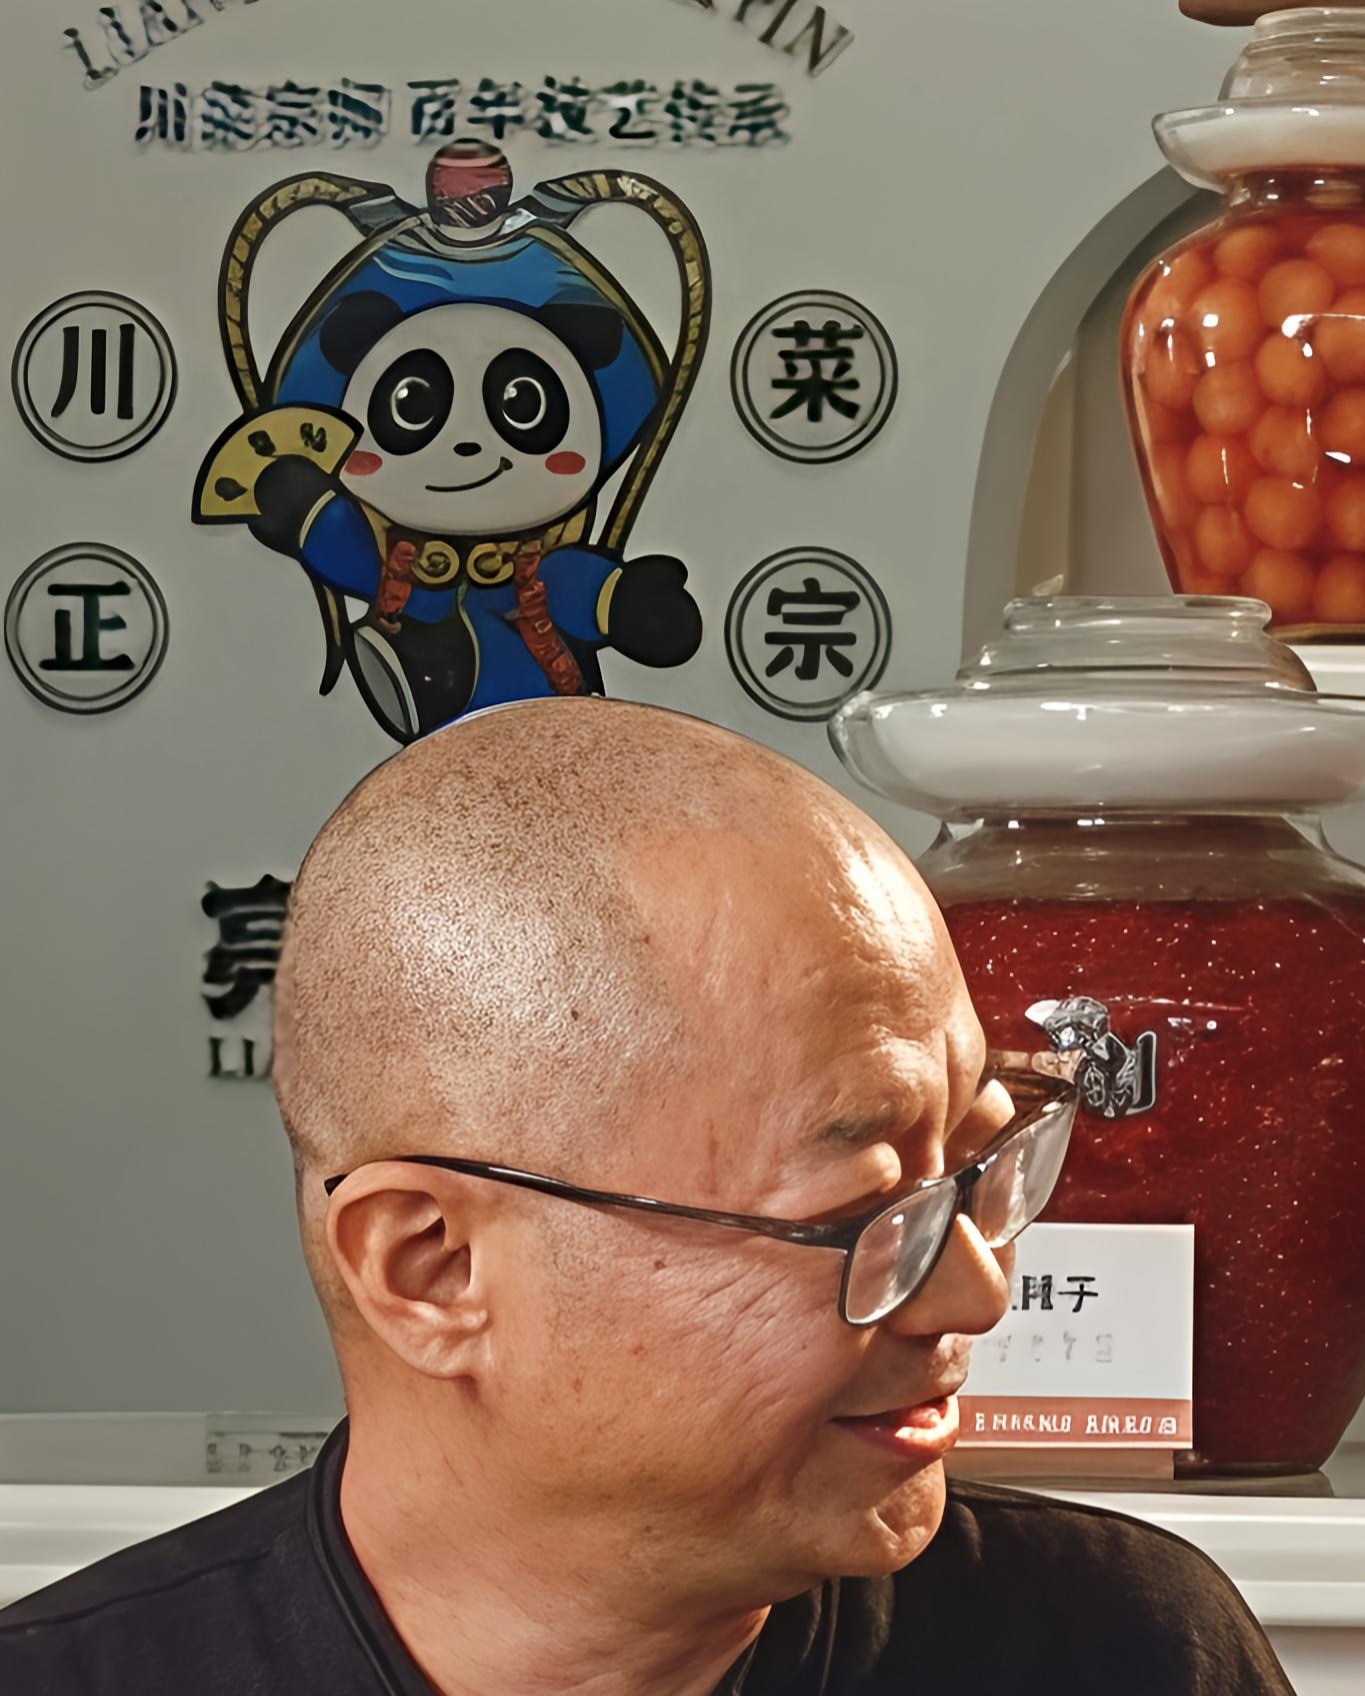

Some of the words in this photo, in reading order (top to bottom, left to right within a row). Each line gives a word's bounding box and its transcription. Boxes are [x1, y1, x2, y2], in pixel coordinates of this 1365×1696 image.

[51, 323, 137, 421] 川
[768, 320, 864, 424] 菜
[39, 581, 136, 673] 正
[763, 577, 862, 681] 宗
